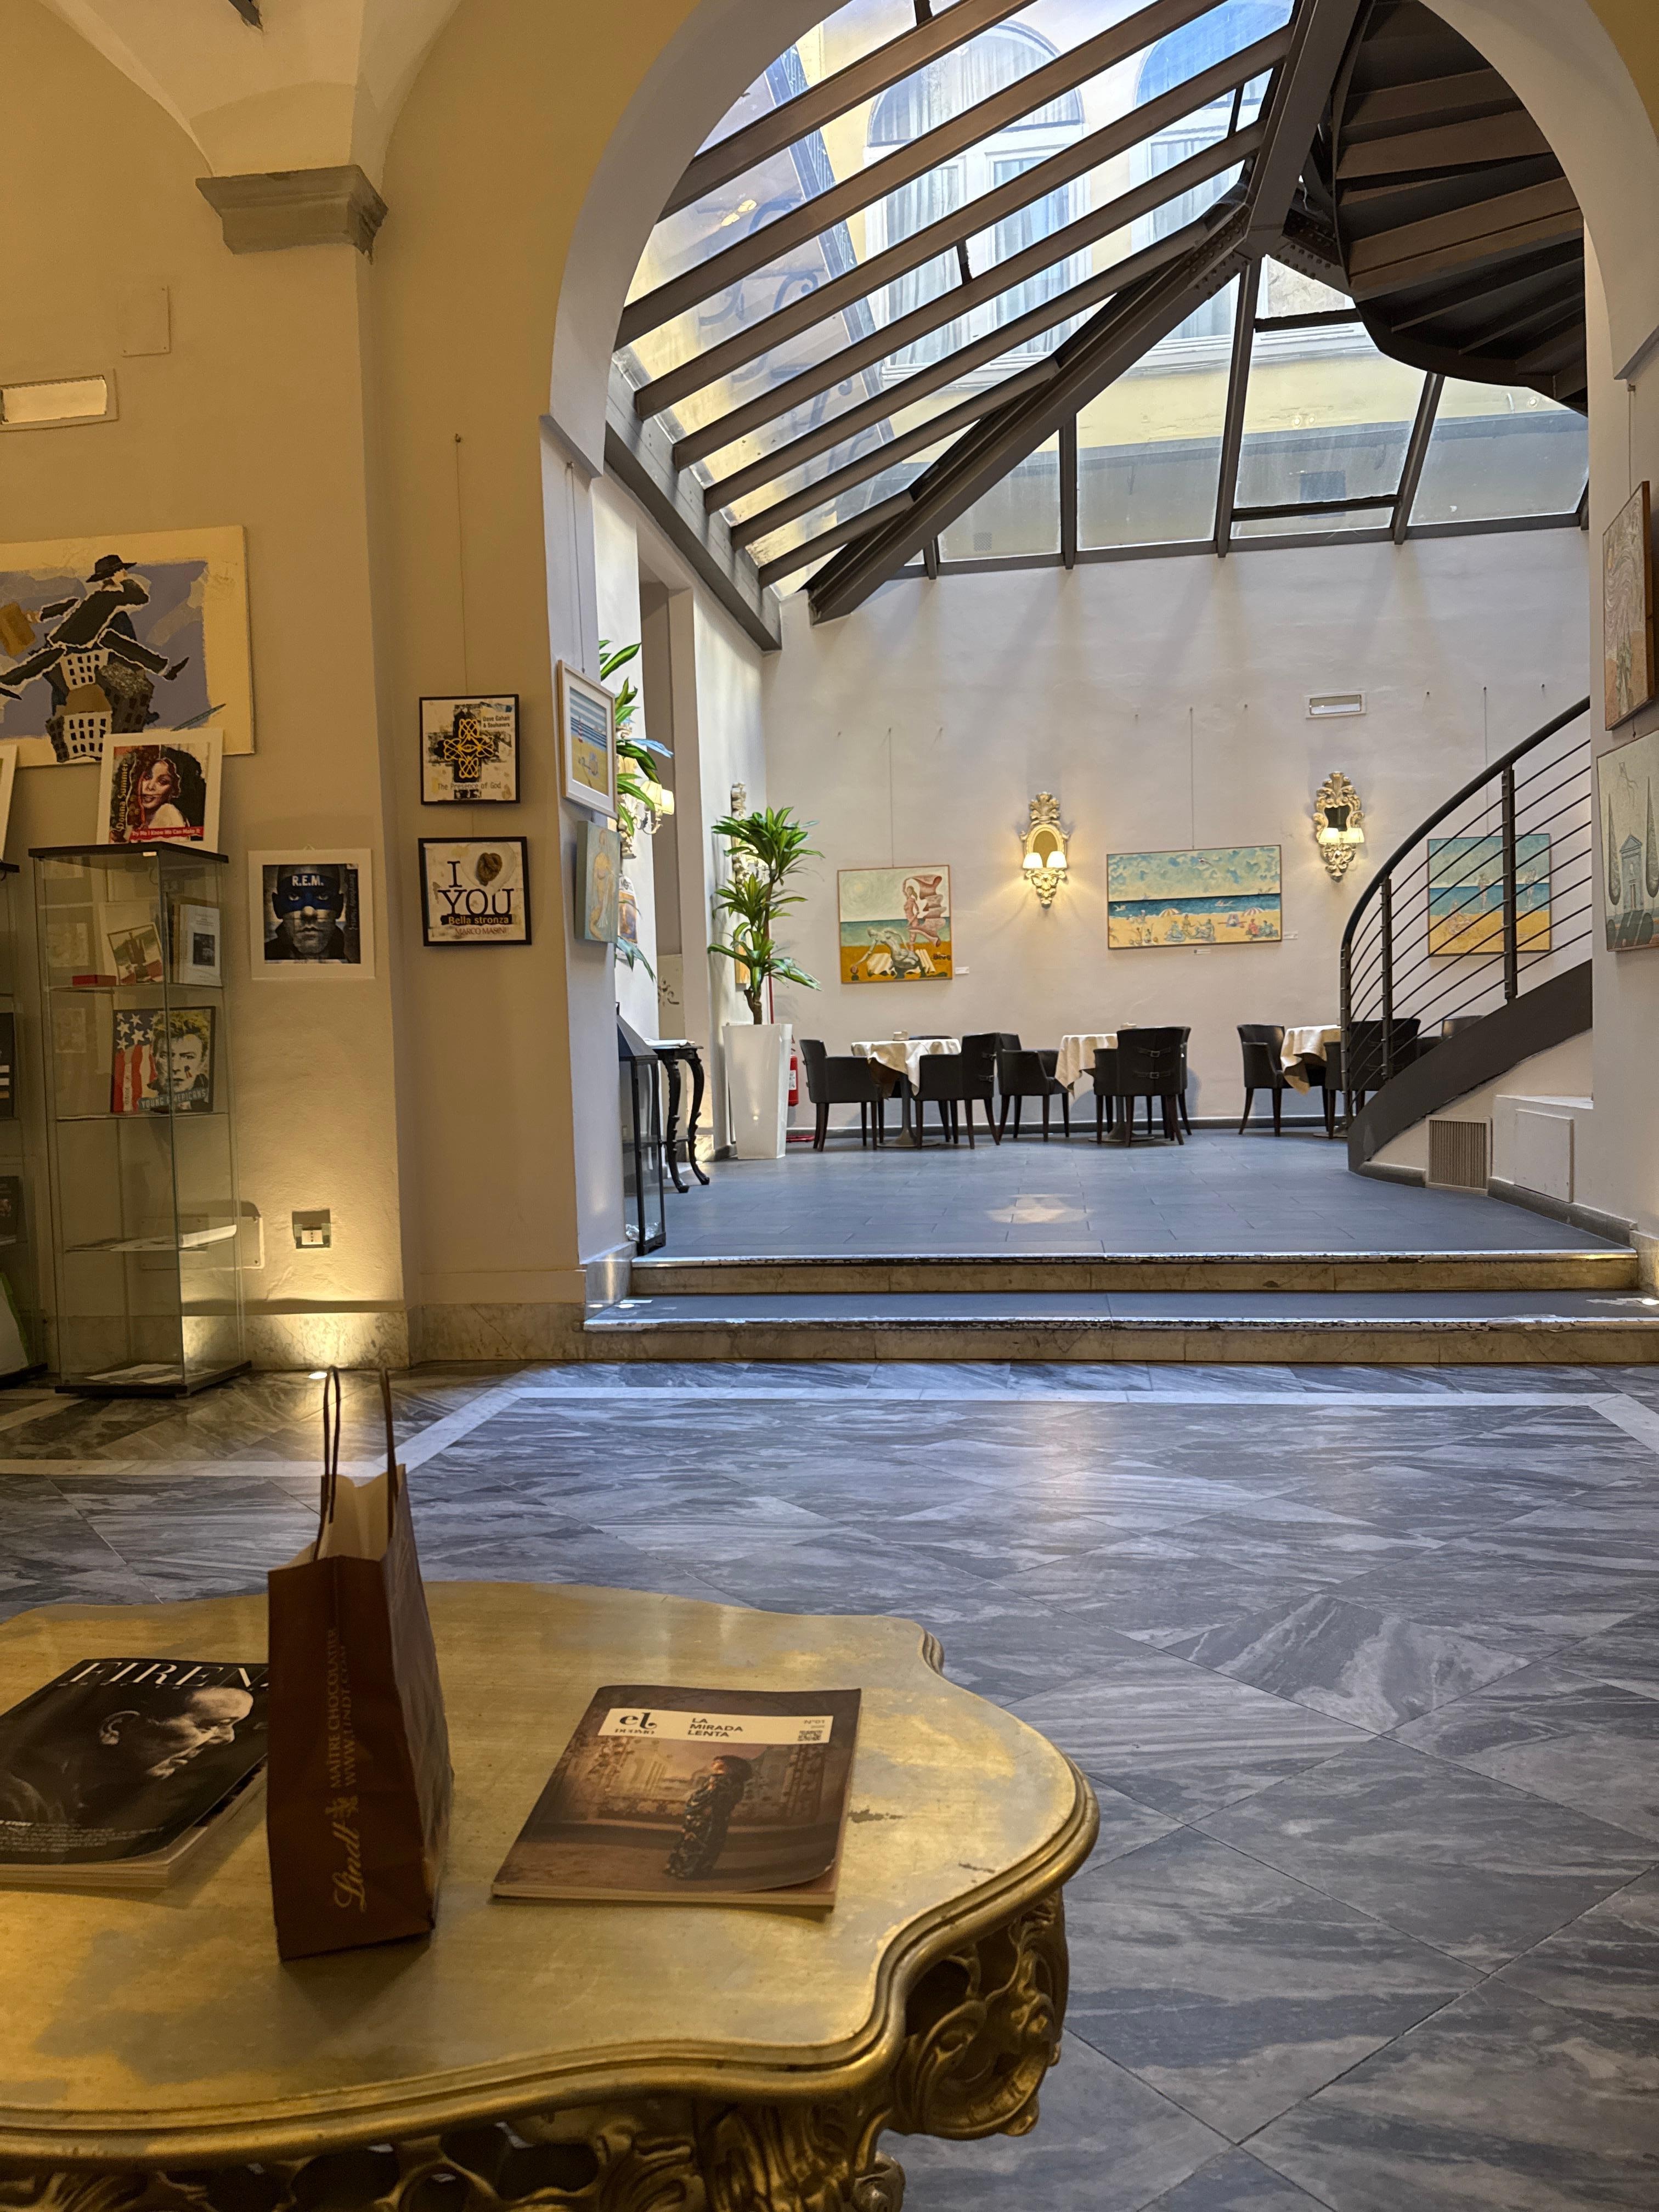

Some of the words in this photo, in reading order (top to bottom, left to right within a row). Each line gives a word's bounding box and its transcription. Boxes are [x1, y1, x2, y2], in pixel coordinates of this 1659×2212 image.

[117, 763, 128, 798] Summer
[116, 801, 126, 830] Donna
[292, 875, 324, 887] R.E.M.
[447, 861, 462, 888] I
[437, 888, 515, 916] YOU
[448, 916, 471, 925] Bella
[474, 916, 509, 924] stronza
[455, 927, 481, 936] MARCO
[482, 927, 507, 935] MASINI
[141, 1098, 164, 1109] YOUNG
[328, 1629, 340, 1730] CHOCOLATIER
[619, 1712, 658, 1730] el
[332, 1820, 368, 1912] Lindt
